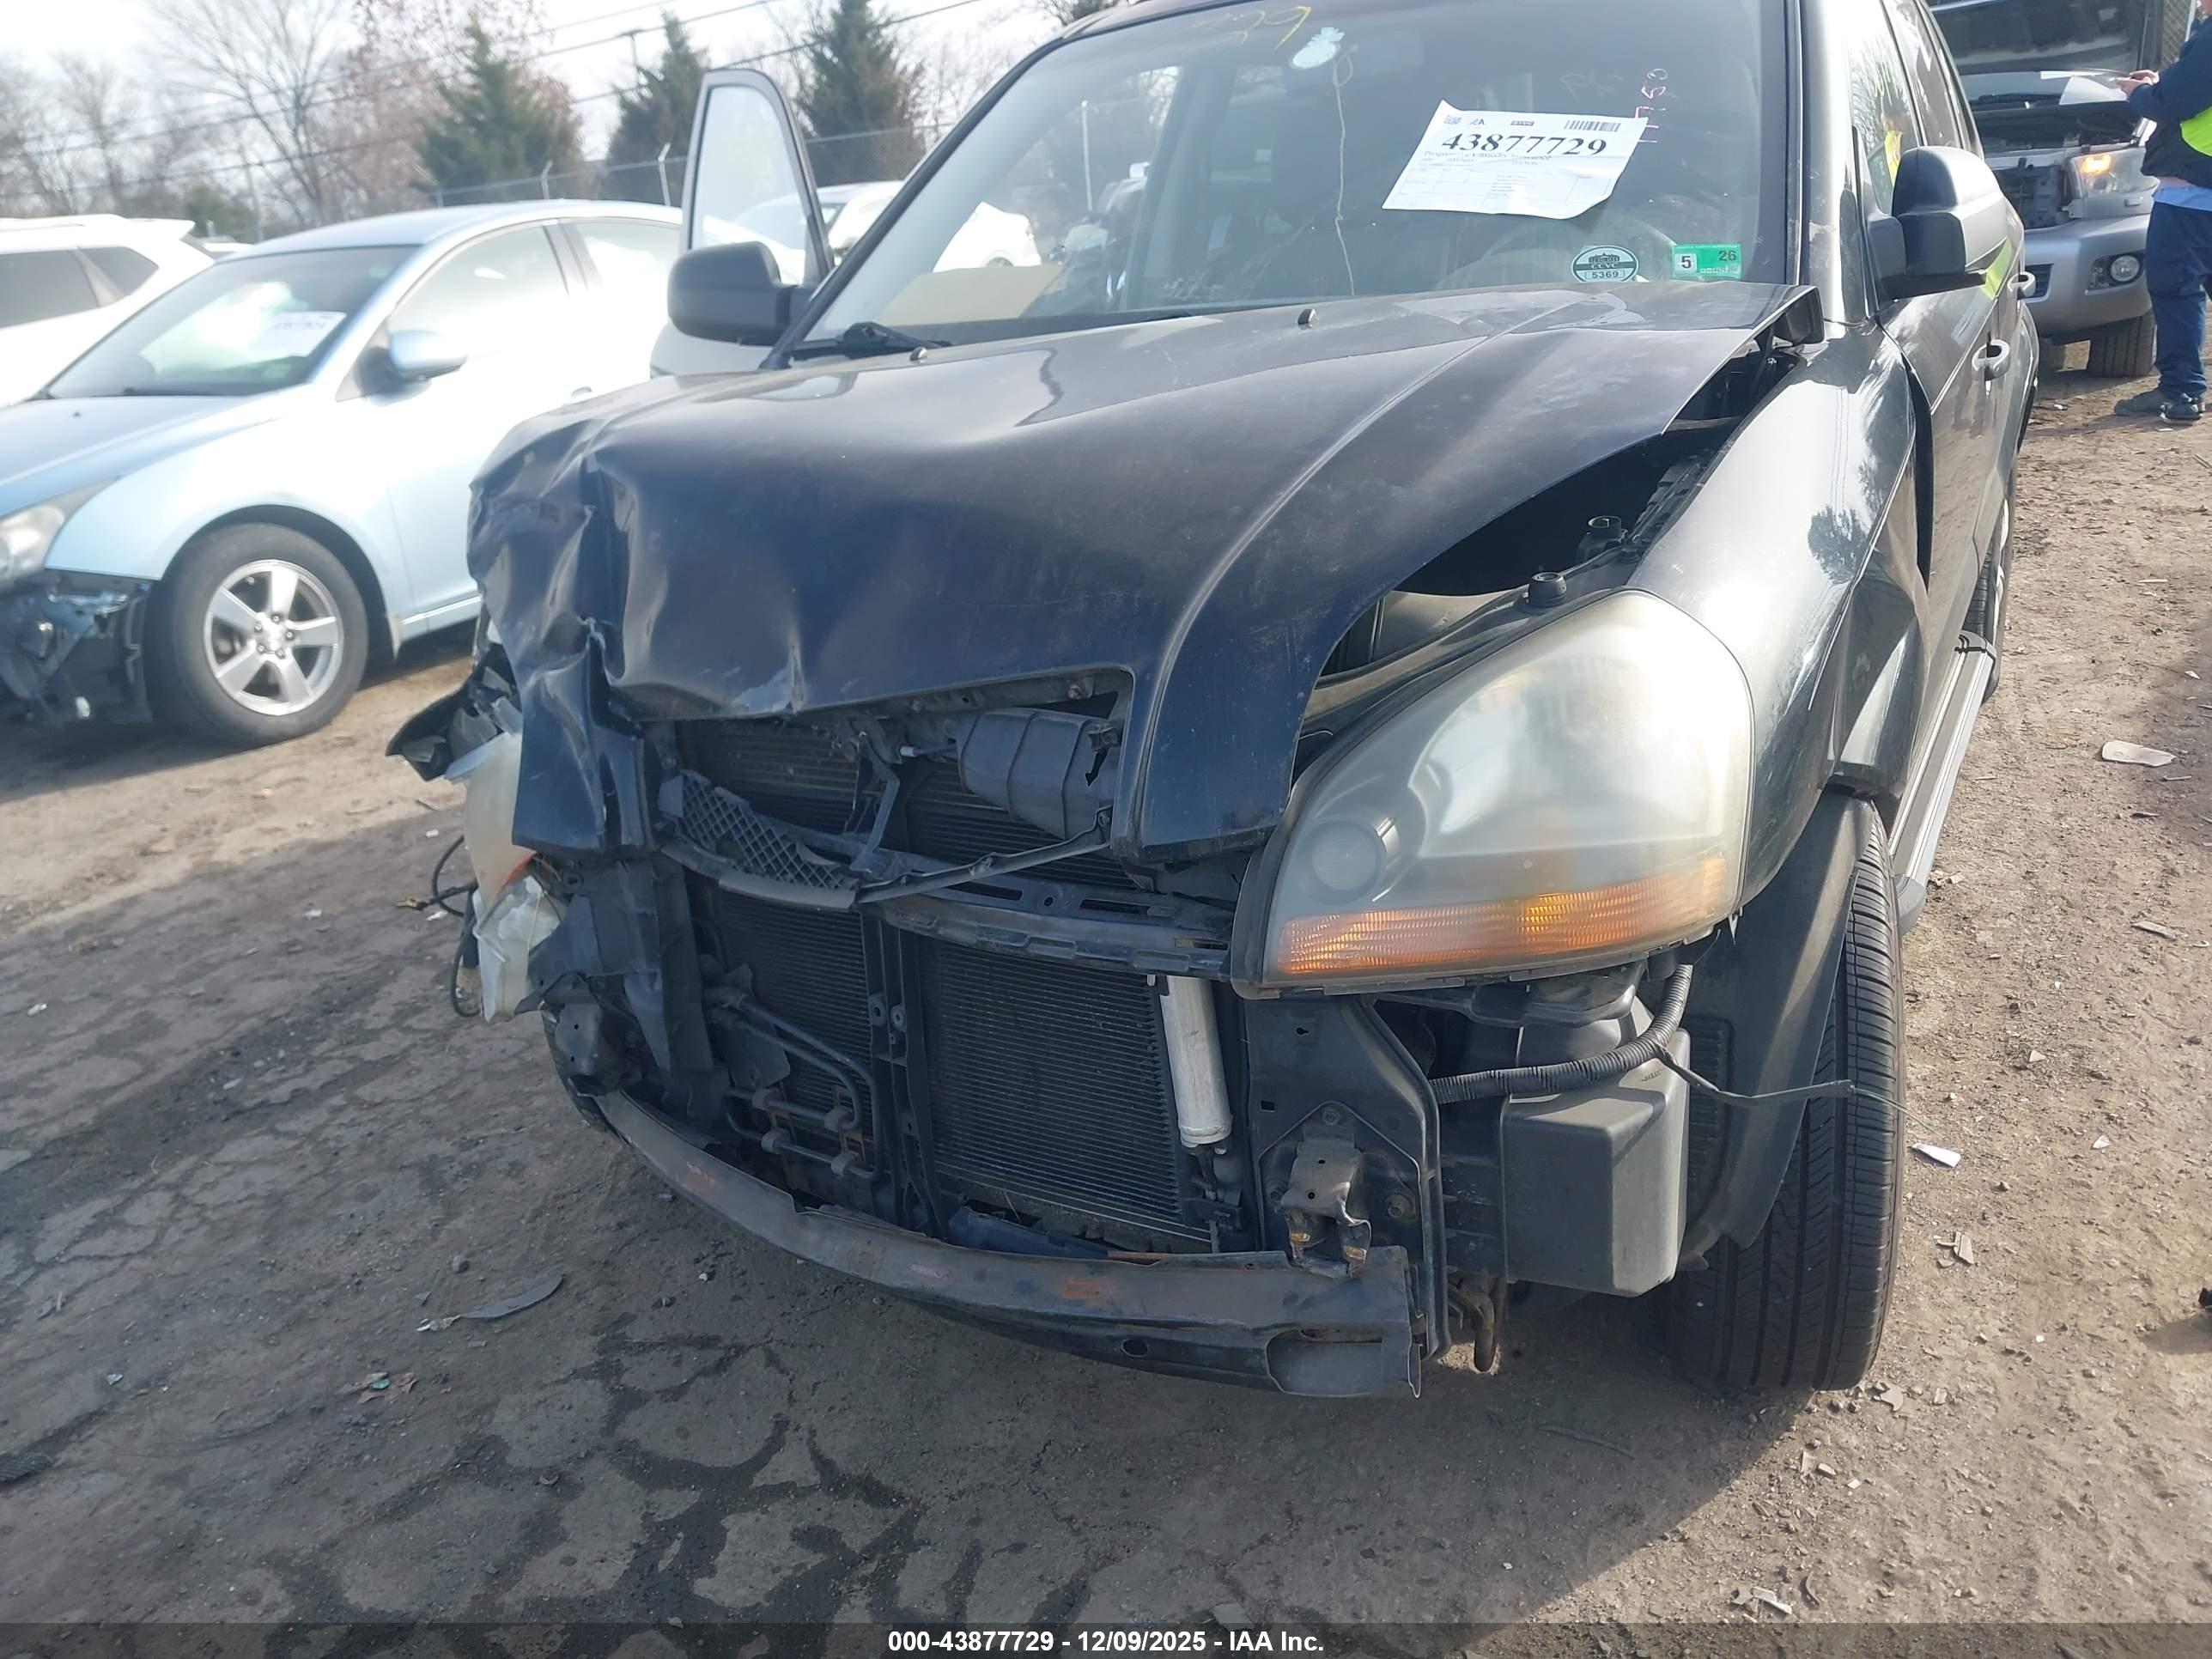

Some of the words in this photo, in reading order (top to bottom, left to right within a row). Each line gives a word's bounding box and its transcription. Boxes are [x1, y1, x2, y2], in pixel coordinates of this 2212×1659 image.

[1442, 133, 1607, 156] 43877729
[1718, 250, 1737, 261] 26
[1681, 255, 1692, 269] 5
[1592, 270, 1620, 279] 5369
